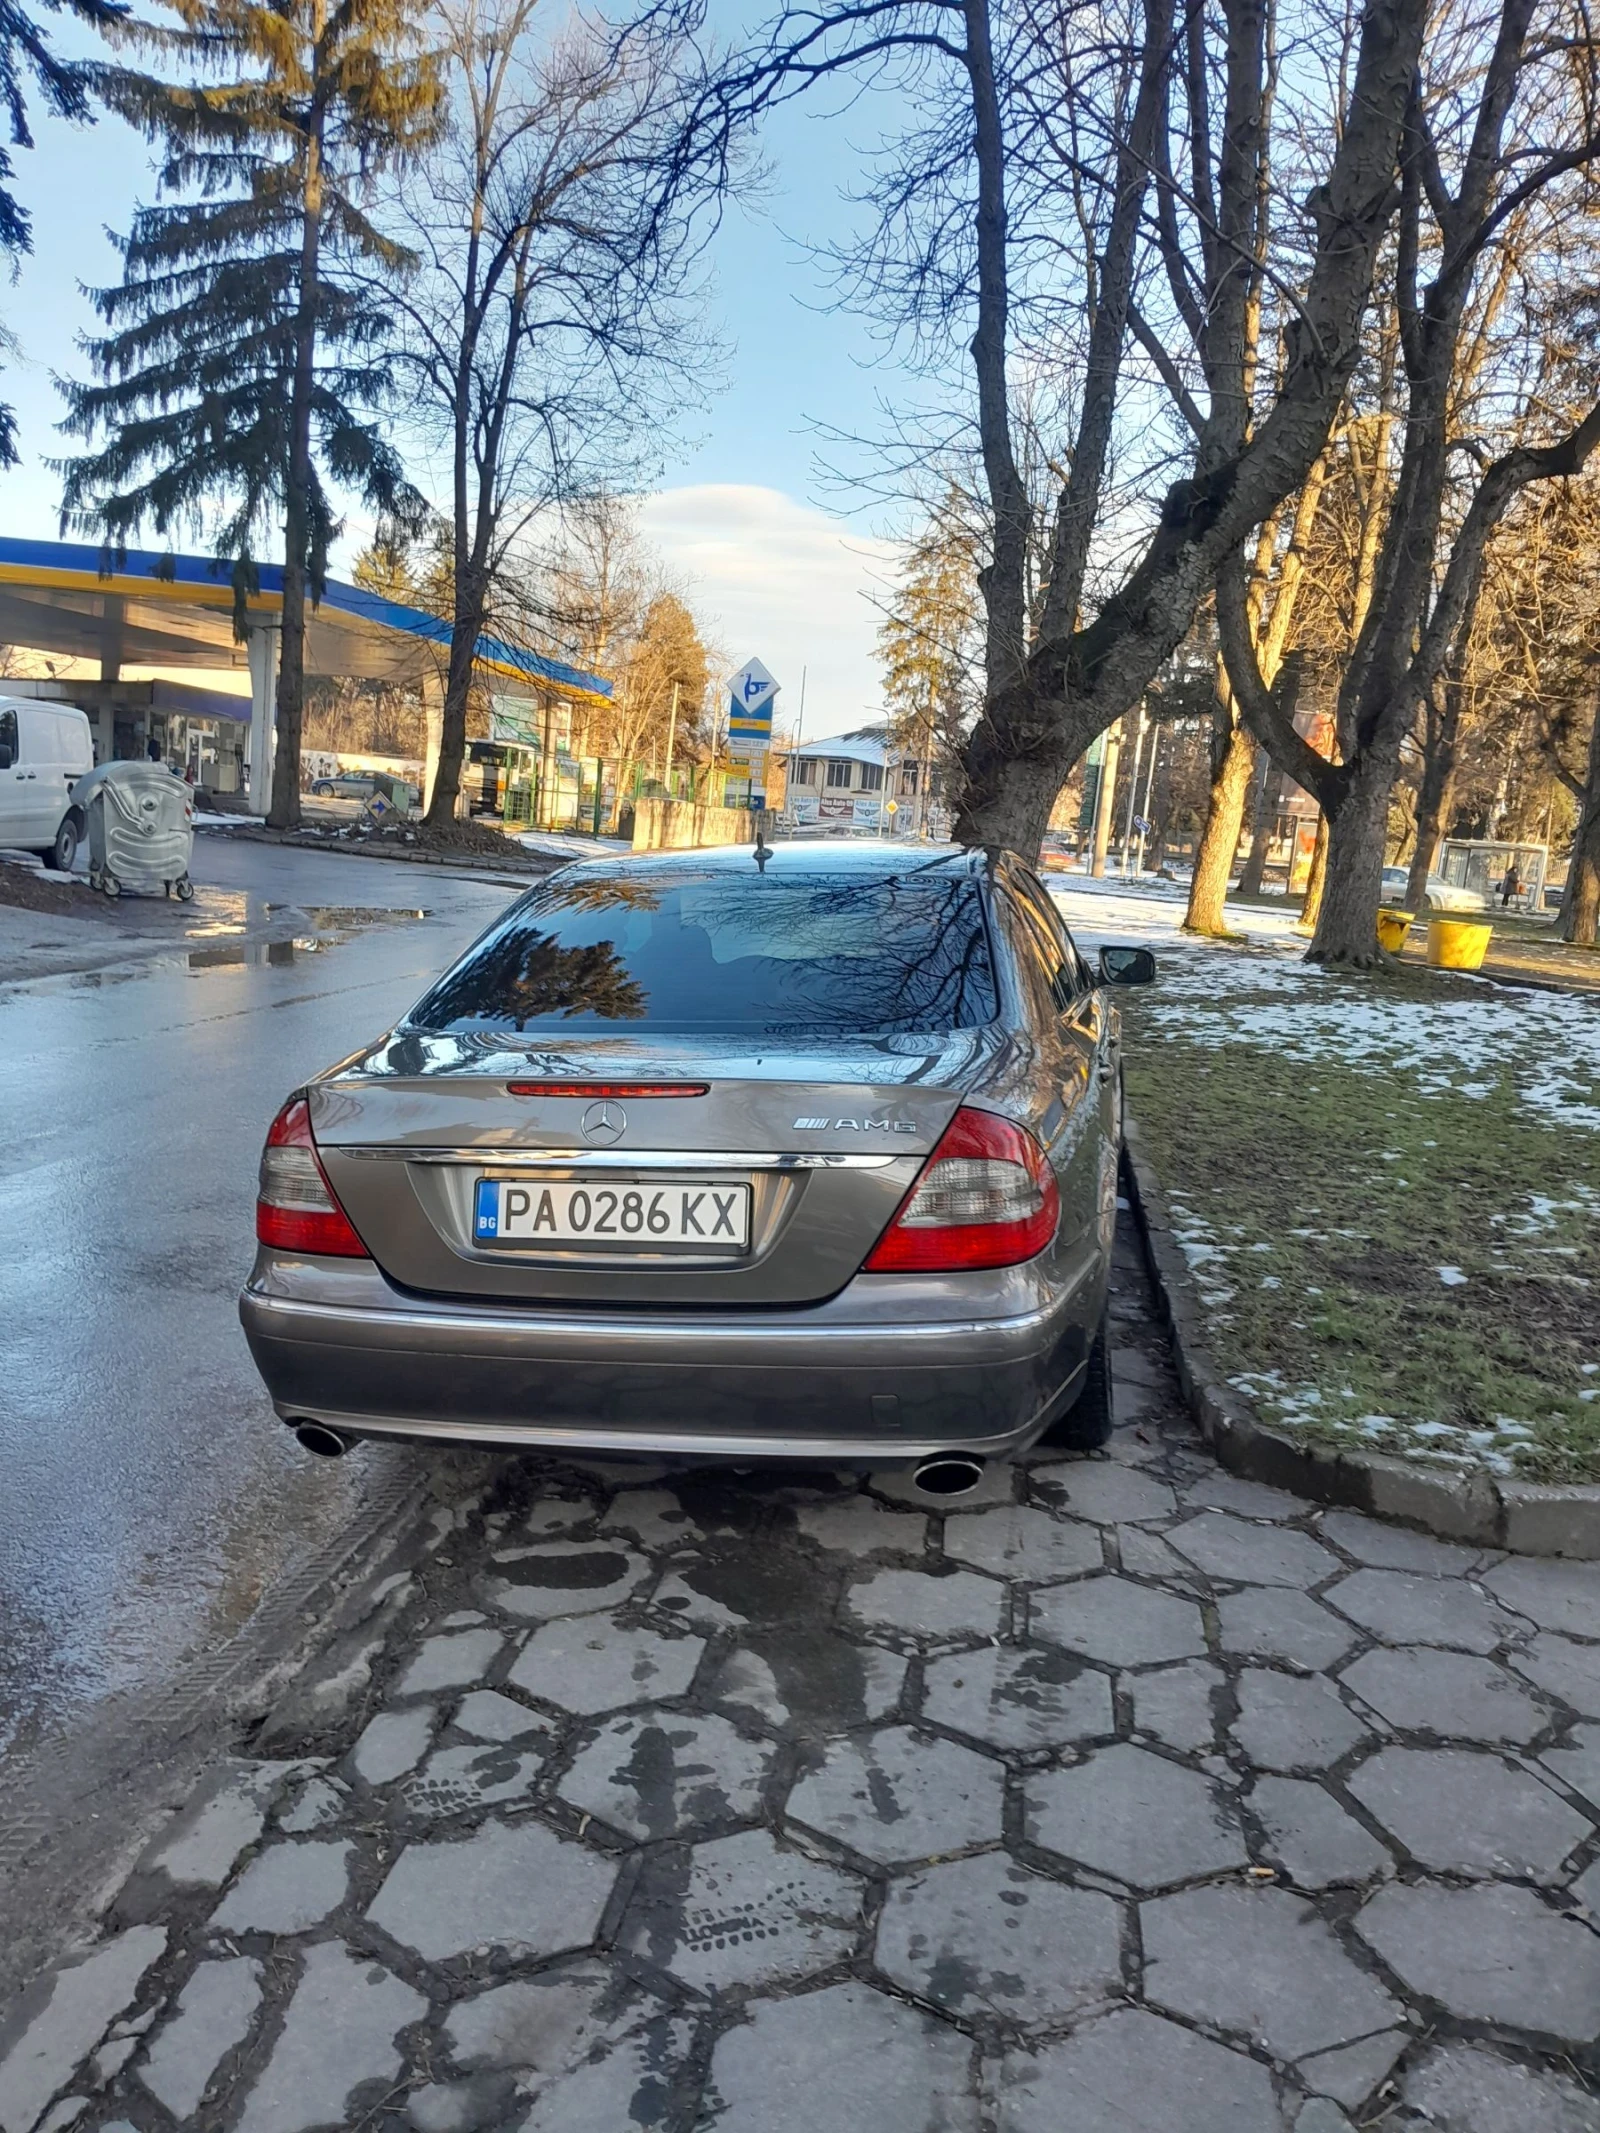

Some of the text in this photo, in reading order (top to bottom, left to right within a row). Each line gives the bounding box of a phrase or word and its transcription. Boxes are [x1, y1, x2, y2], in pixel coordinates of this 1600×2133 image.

[834, 1119, 916, 1133] AMG
[505, 1189, 737, 1236] PA 0286 KX
[479, 1216, 496, 1229] BG
